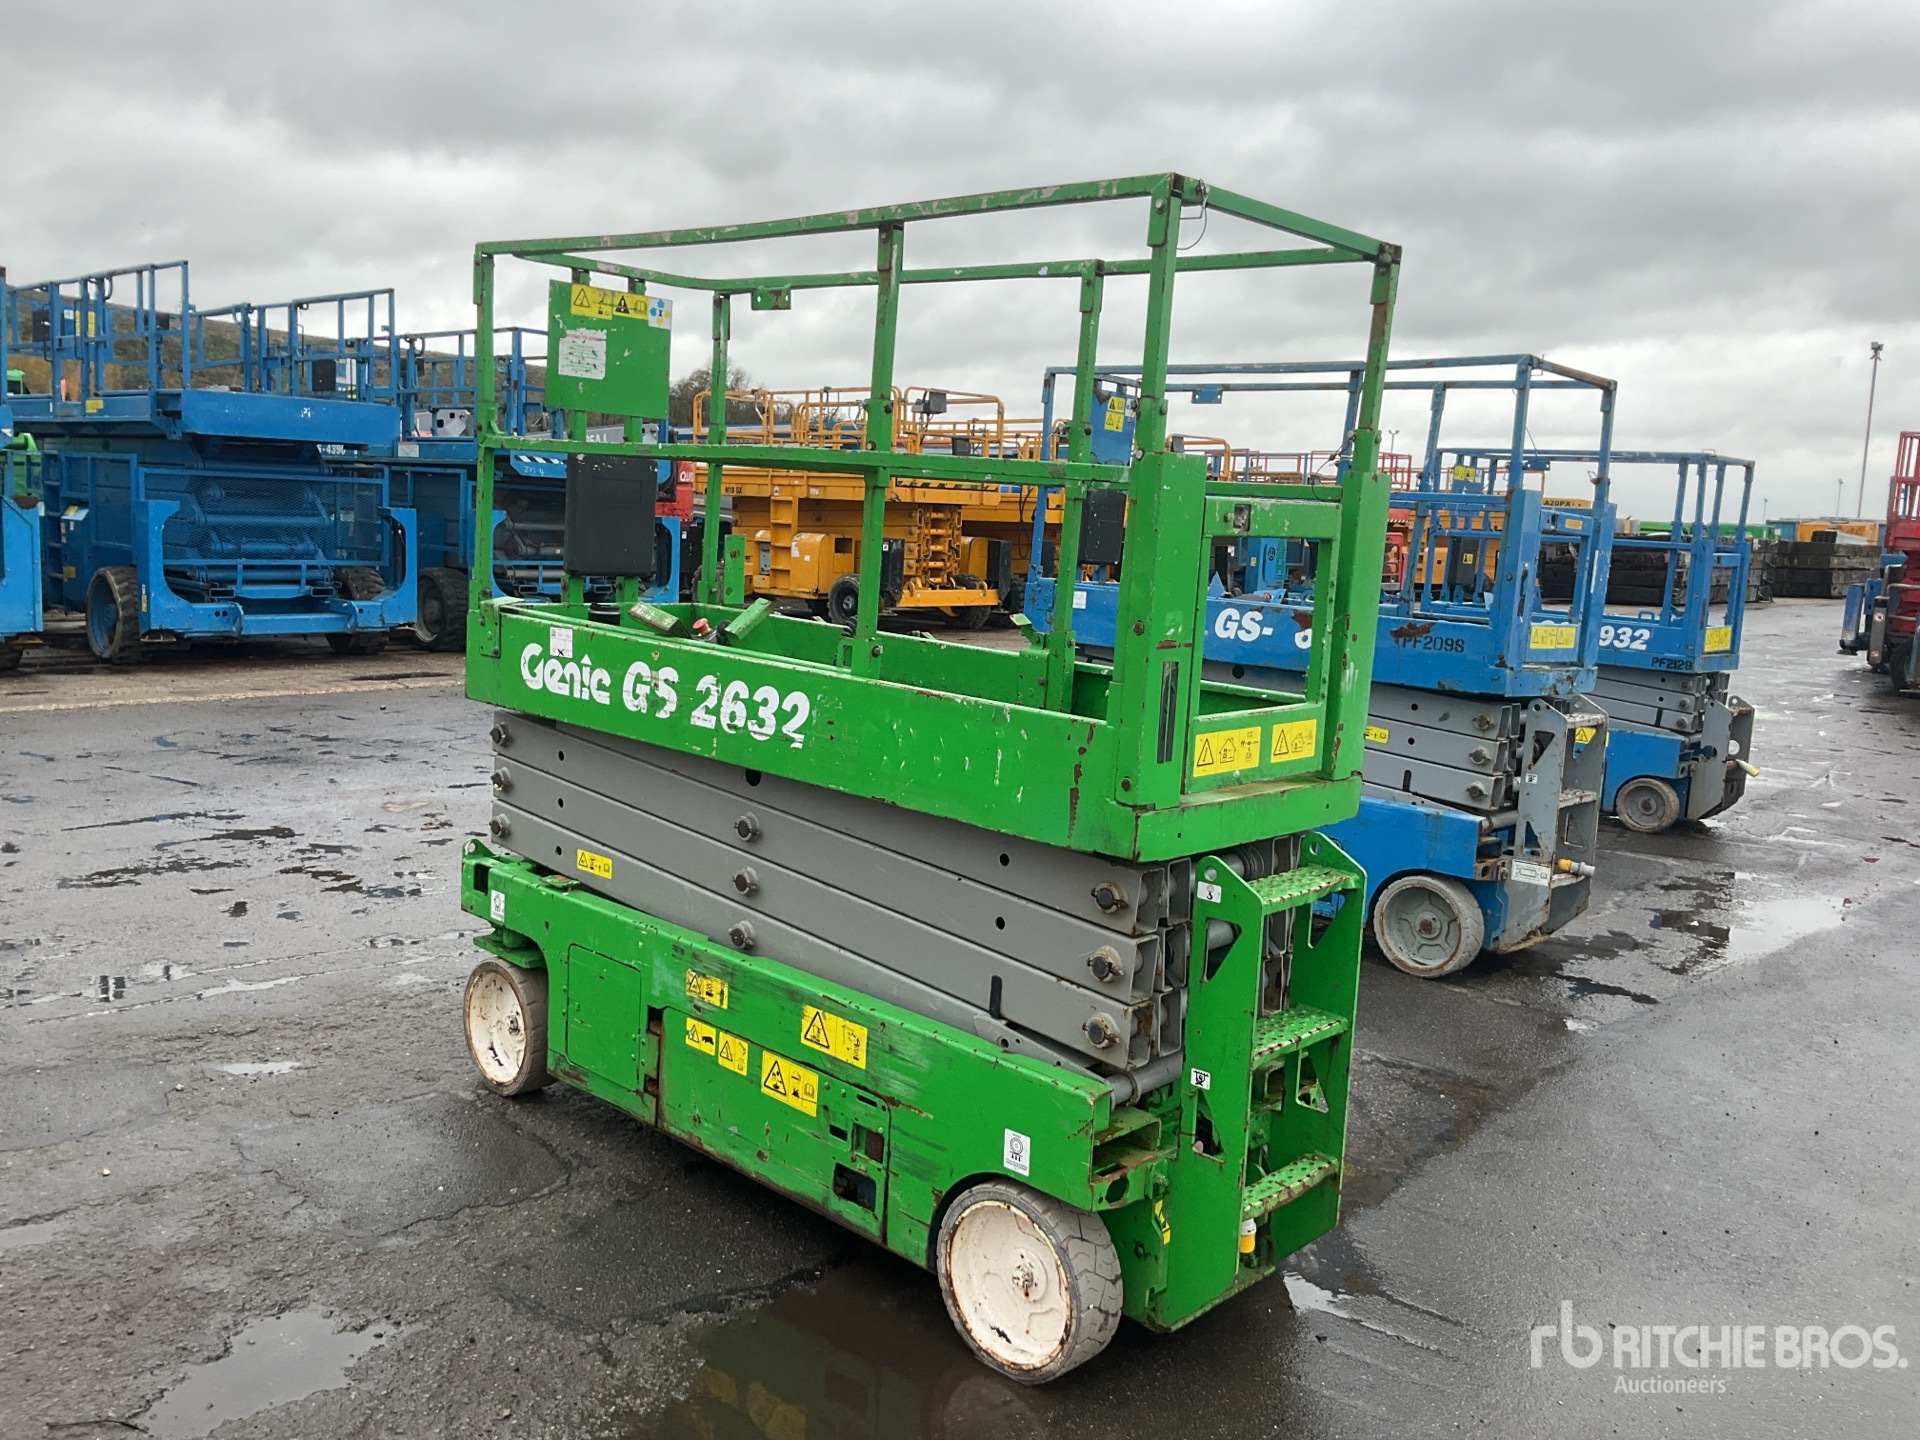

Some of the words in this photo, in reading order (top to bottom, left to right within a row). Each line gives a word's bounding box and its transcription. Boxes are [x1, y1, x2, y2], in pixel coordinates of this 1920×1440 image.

[1651, 656, 1693, 671] PF2129
[622, 661, 679, 719] GS
[690, 674, 811, 749] 2632
